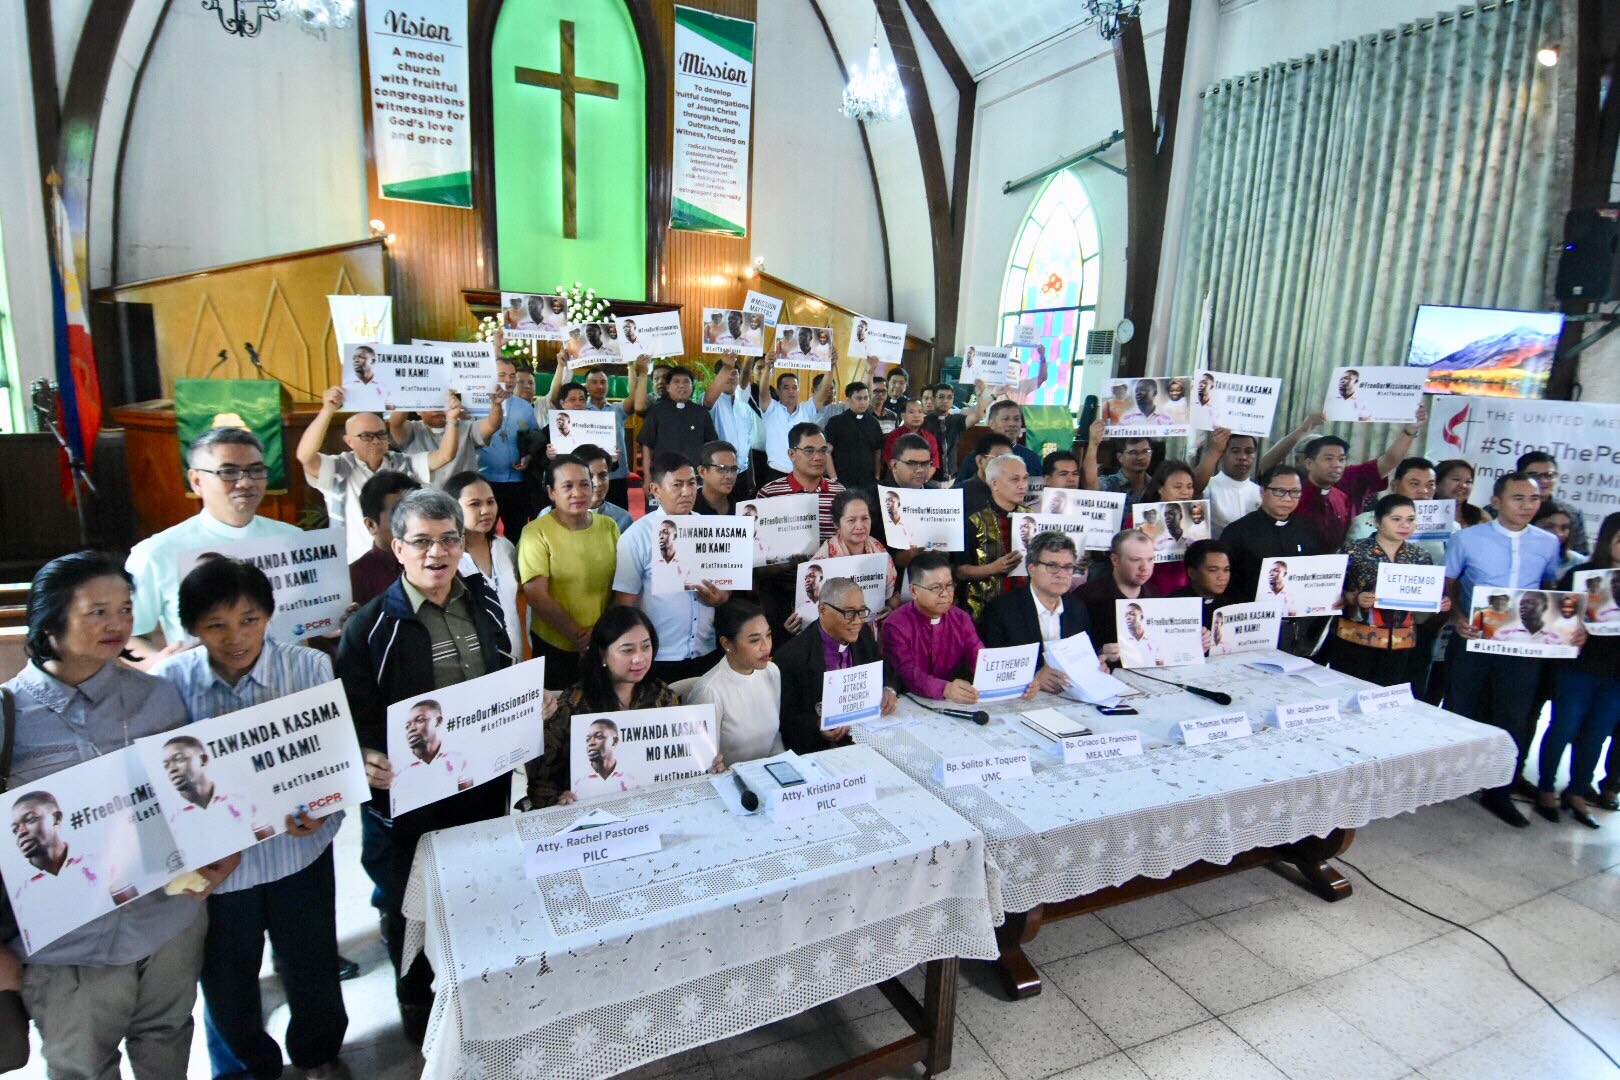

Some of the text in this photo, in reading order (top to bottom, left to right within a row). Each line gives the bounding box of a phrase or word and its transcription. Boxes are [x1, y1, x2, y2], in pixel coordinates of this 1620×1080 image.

[384, 10, 453, 42] Vision
[392, 47, 445, 63] A model
[397, 62, 441, 76] church
[679, 52, 747, 84] Mission
[381, 74, 457, 93] with fruitful
[374, 88, 465, 107] congregations
[704, 86, 732, 98] develop
[701, 95, 749, 110] congregations
[375, 102, 465, 121] witnessing for
[697, 103, 715, 113] Jesus
[716, 107, 737, 117] Christ
[389, 117, 454, 132] God's love
[683, 110, 741, 127] through Nurture,
[687, 120, 736, 135] Outreach, and
[392, 131, 453, 146] and grace
[676, 128, 706, 140] Witness,
[707, 133, 736, 145] focusing
[707, 145, 737, 156] hospitality
[750, 297, 777, 311] #MISSION
[377, 353, 445, 366] TAWANDA KASAMA
[453, 360, 463, 368] MO
[395, 368, 429, 378] MO KAMI!
[1215, 381, 1273, 396] TAWANDA KASAMA
[1359, 381, 1422, 391] #FreeOurMissionaries
[1236, 396, 1257, 406] KAMI!
[1487, 410, 1582, 427] THE UNITED
[1104, 428, 1157, 437] #LetThemLeave
[1575, 472, 1594, 486] of
[1570, 490, 1582, 502] a
[902, 505, 961, 516] #FreeOurMissionaries
[1096, 499, 1119, 510] KASAMA
[1418, 504, 1439, 515] STOP
[759, 513, 817, 528] #FreeOurMissionaries
[1422, 515, 1433, 523] THE
[678, 527, 747, 539] TAWANDA KASAMA
[1063, 524, 1084, 534] KASAMA
[290, 544, 338, 565] KASAMA
[695, 542, 731, 554] MO KAMI!
[284, 568, 319, 588] KAMI!
[1288, 572, 1342, 582] #FreeOurMissionaries
[1387, 574, 1436, 585] LET THEM GO
[1399, 586, 1422, 595] HOME
[279, 593, 341, 612] #LetThemLeave
[305, 618, 331, 630] PCPR
[1146, 617, 1199, 626] #FreeOurMissionaries
[1223, 610, 1276, 625] TAWANDA KASAMA
[1234, 625, 1243, 635] MO
[1474, 642, 1542, 656] #LetThemLeave
[985, 657, 1030, 672] LET THEM GO
[842, 670, 868, 684] STOP THE
[996, 670, 1017, 682] HOME
[842, 682, 867, 694] ATTACKS
[838, 690, 870, 704] ON CHURCH
[446, 688, 540, 733] #FreeOurMissionaries
[842, 701, 865, 713] PEOPLE!
[480, 706, 534, 734] #LetThemLeave
[1195, 720, 1221, 729] Thomas
[1220, 715, 1244, 725] Kemper
[206, 701, 340, 760] TAWANDA KASAMA
[620, 720, 708, 743] TAWANDA KASAA
[1208, 730, 1228, 741] GBGM
[1065, 733, 1137, 750] Bp. Ciriaco Q. Francisco
[251, 734, 322, 773] MO KAMI!
[646, 743, 692, 762] MO KAMI!
[1085, 748, 1122, 760] MEA UMC
[946, 753, 1027, 774] Bp. Solito K. Toquero
[271, 760, 350, 794] #LetThemLeave
[981, 771, 1002, 783] UMC
[782, 774, 866, 802] Atty. Kristina Conti
[70, 782, 156, 830] #FreeOurMi
[307, 791, 342, 811] PCPR
[817, 798, 837, 811] PILC
[536, 824, 649, 854] Atty. Rachel Pastores
[582, 848, 609, 863] PILC
